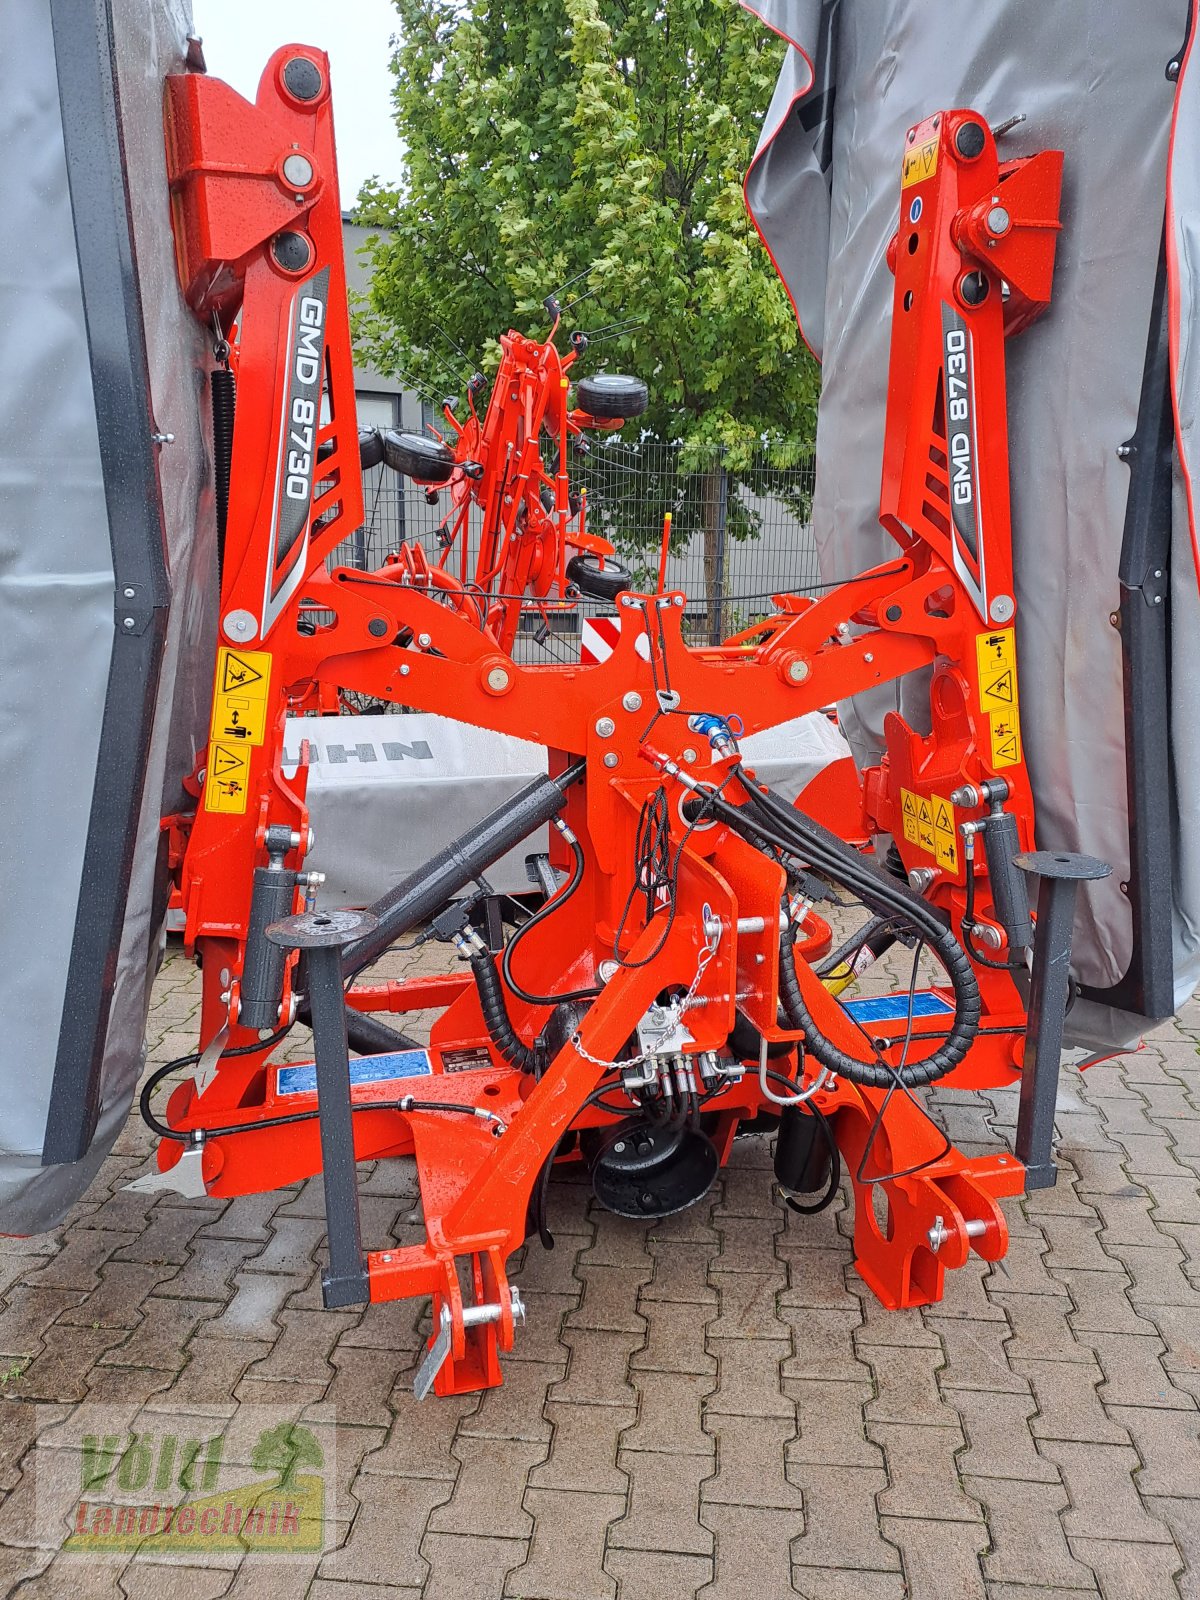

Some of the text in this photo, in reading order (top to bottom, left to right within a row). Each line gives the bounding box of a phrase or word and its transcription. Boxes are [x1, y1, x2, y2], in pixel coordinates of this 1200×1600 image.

[286, 297, 322, 500] GMD 8730
[946, 330, 972, 505] GMD 8730
[281, 740, 434, 766] UHN
